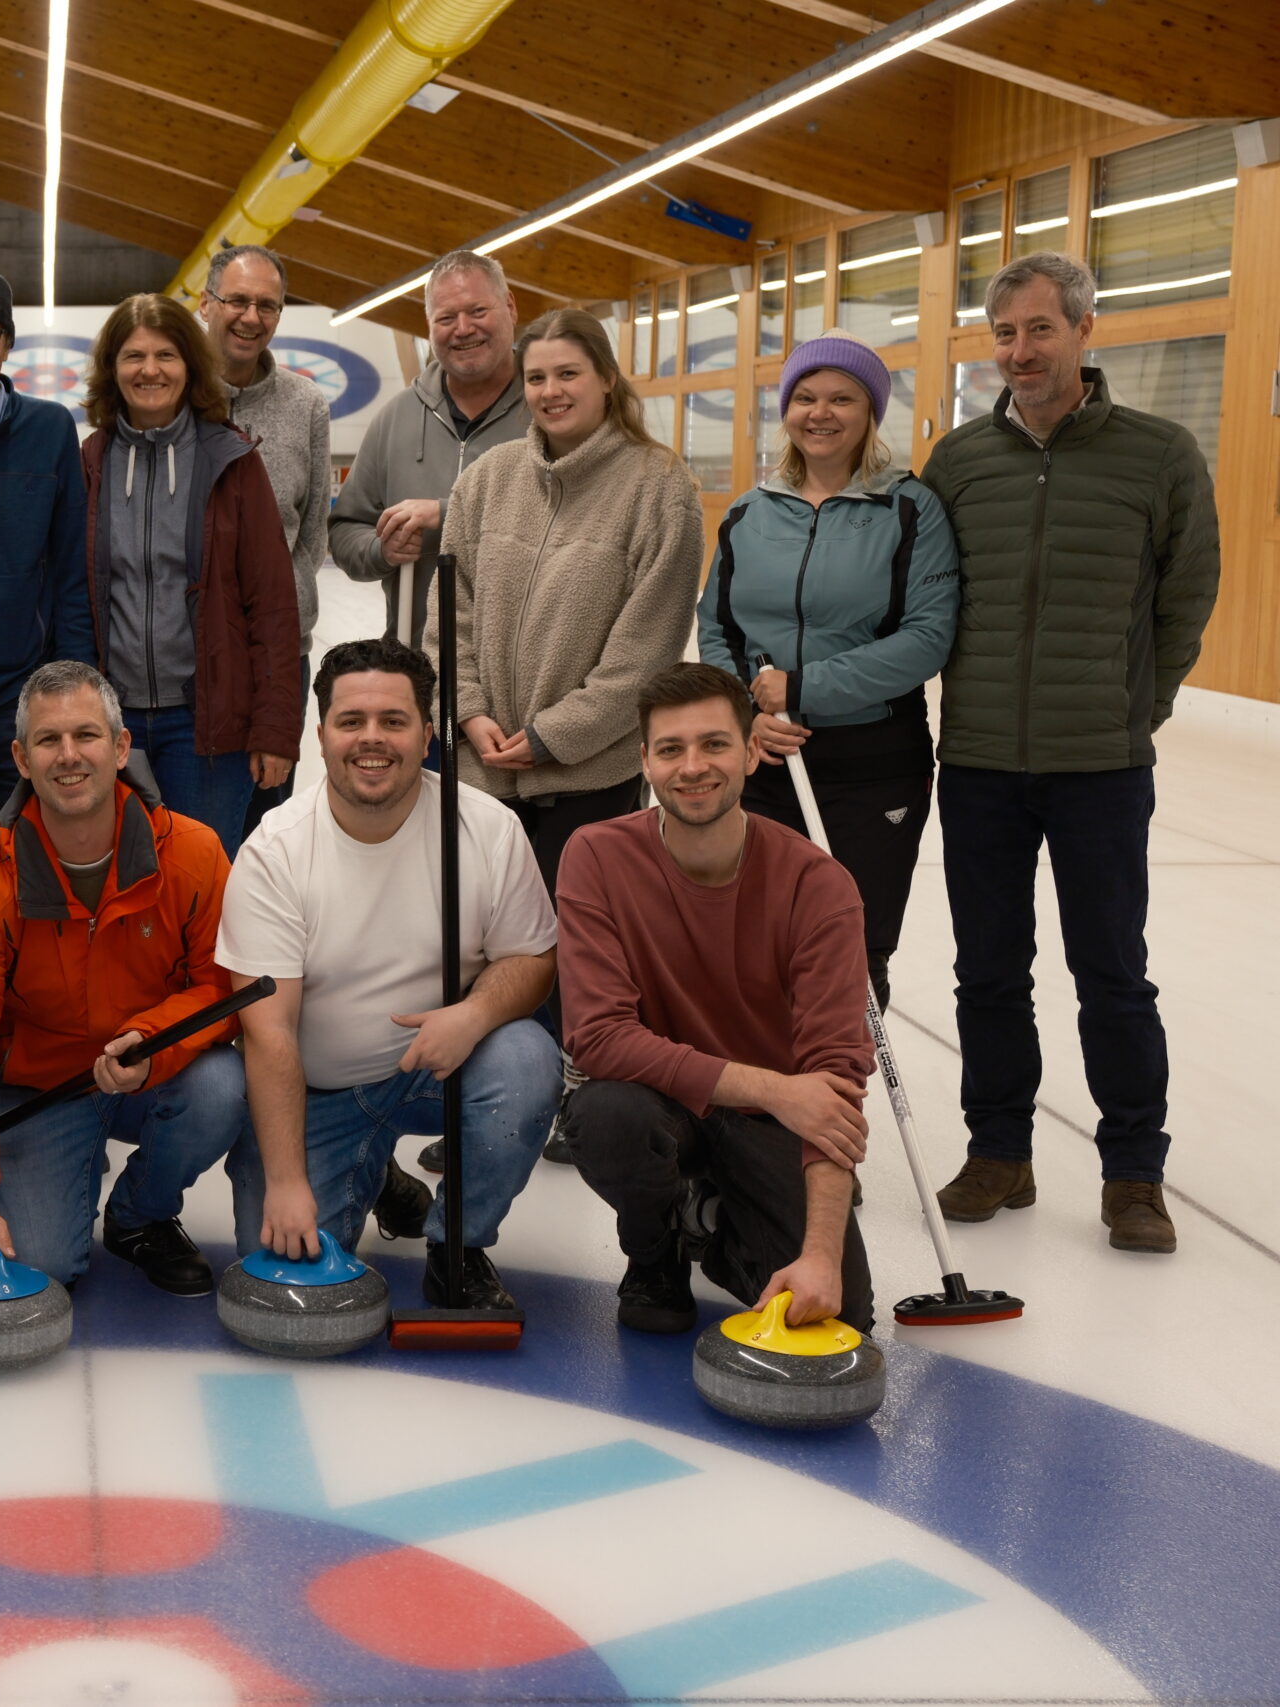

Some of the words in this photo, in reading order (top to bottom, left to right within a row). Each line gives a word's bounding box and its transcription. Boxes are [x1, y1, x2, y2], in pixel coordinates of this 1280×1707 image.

[881, 1051, 898, 1088] Olson
[2, 1284, 10, 1294] 3
[752, 1332, 762, 1342] 3
